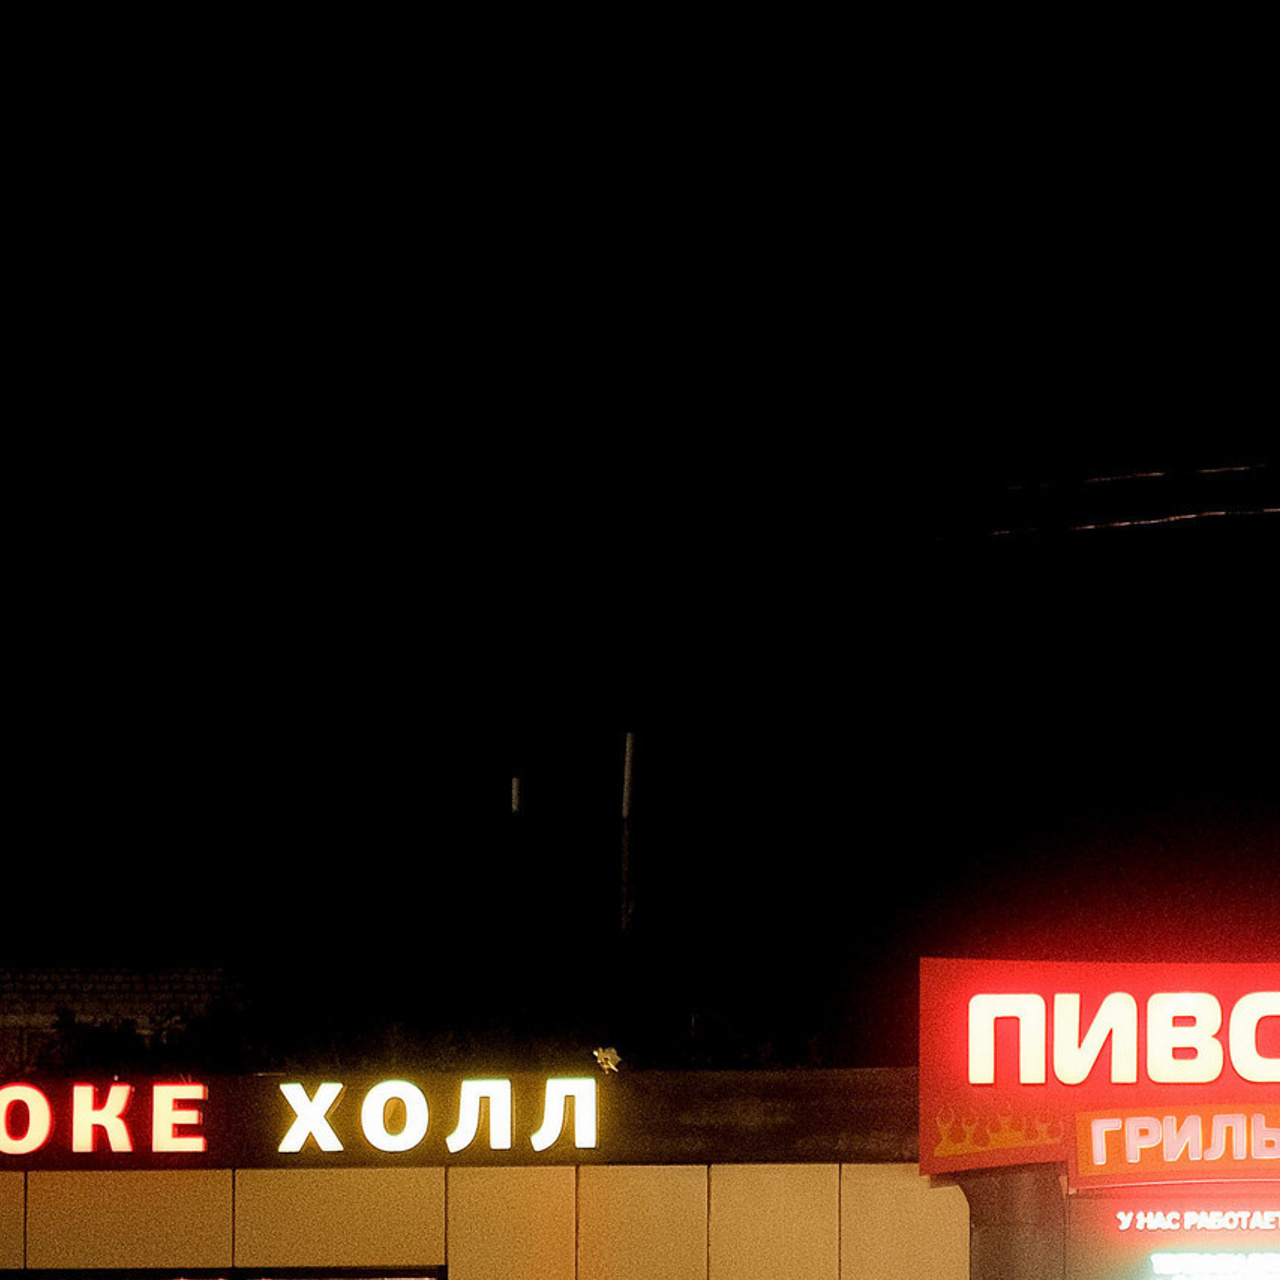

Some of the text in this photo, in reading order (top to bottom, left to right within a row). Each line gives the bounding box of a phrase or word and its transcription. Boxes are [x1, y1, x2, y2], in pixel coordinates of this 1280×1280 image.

[0, 1077, 598, 1155] ОКЕ ХОЛЛ
[1116, 1210, 1134, 1231] У
[1136, 1210, 1181, 1231] НАС
